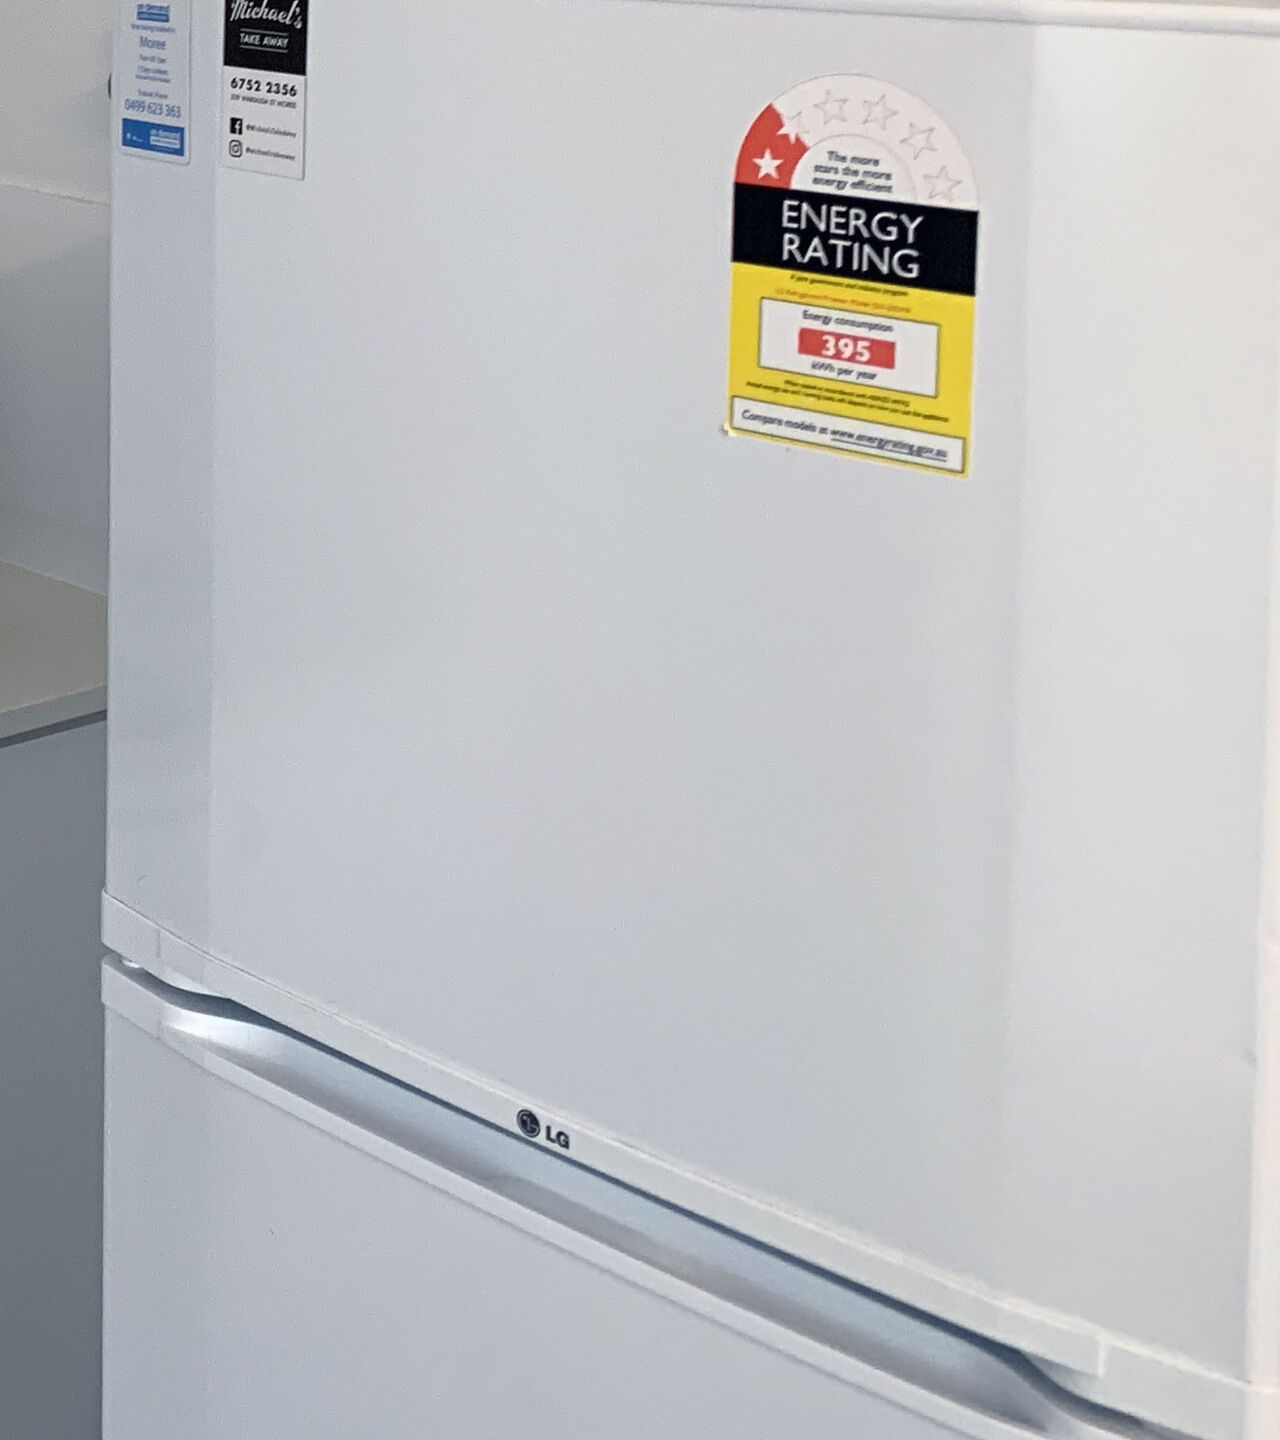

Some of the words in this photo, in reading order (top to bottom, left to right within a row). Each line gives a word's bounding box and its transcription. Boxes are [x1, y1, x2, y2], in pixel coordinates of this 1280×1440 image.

[240, 33, 261, 45] TAKE
[262, 36, 289, 48] AWAY
[230, 77, 261, 92] 6752
[266, 81, 298, 97] 2356
[827, 150, 847, 163] The
[850, 156, 880, 167] more
[814, 164, 839, 175] stars
[842, 166, 860, 177] the
[862, 170, 893, 181] more
[812, 177, 848, 191] energy
[850, 179, 893, 193] efficient
[782, 200, 924, 243] ENERGY
[782, 233, 921, 279] RATING
[802, 309, 833, 326] Energy
[834, 317, 894, 333] consumption
[821, 334, 871, 363] 395
[837, 367, 854, 378] per
[856, 371, 878, 381] year
[742, 409, 782, 426] Compare
[784, 420, 817, 433] models
[819, 426, 829, 435] at
[546, 1125, 570, 1150] LG
